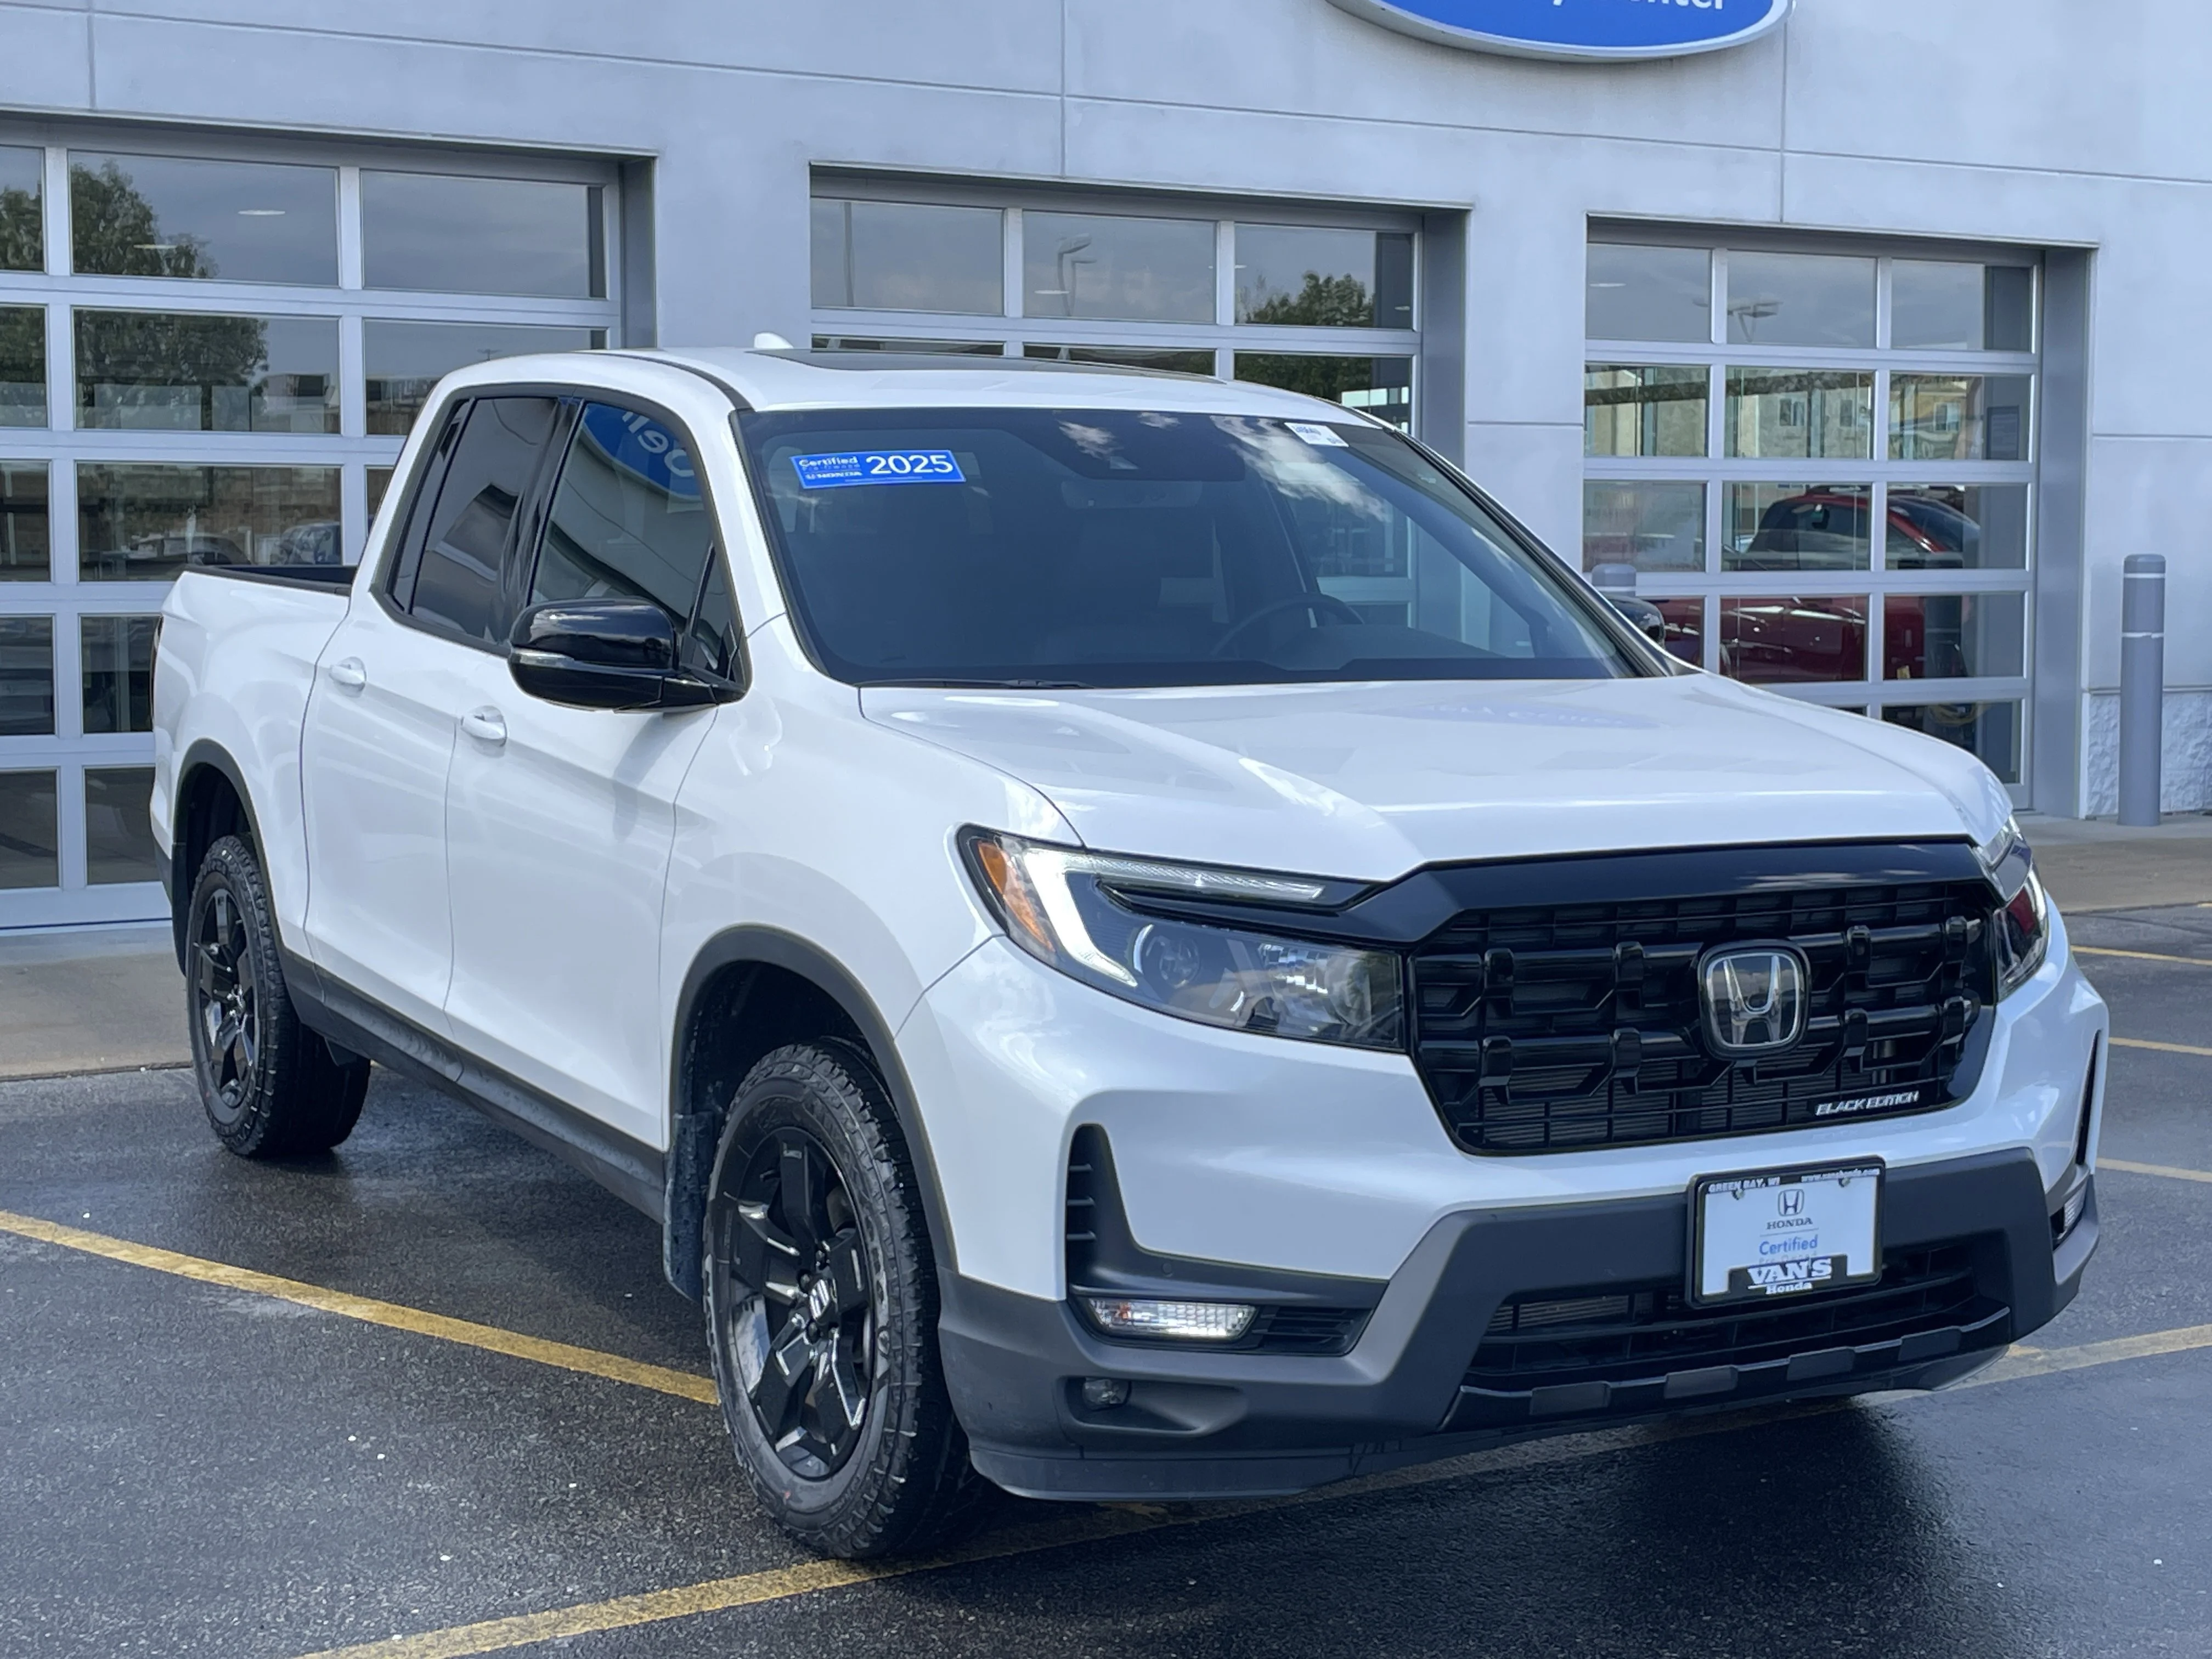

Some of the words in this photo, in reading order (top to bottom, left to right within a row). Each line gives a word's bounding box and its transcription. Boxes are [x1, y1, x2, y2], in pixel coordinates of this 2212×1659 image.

[799, 456, 858, 467] Certified
[866, 455, 953, 475] 2025
[1815, 1099, 1865, 1116] BLACK
[1866, 1091, 1919, 1109] EDITION
[1709, 1181, 1742, 1193] GREEN
[1766, 1217, 1813, 1229] HONDA
[1759, 1234, 1818, 1255] Certified
[1765, 1282, 1813, 1295] Honda
